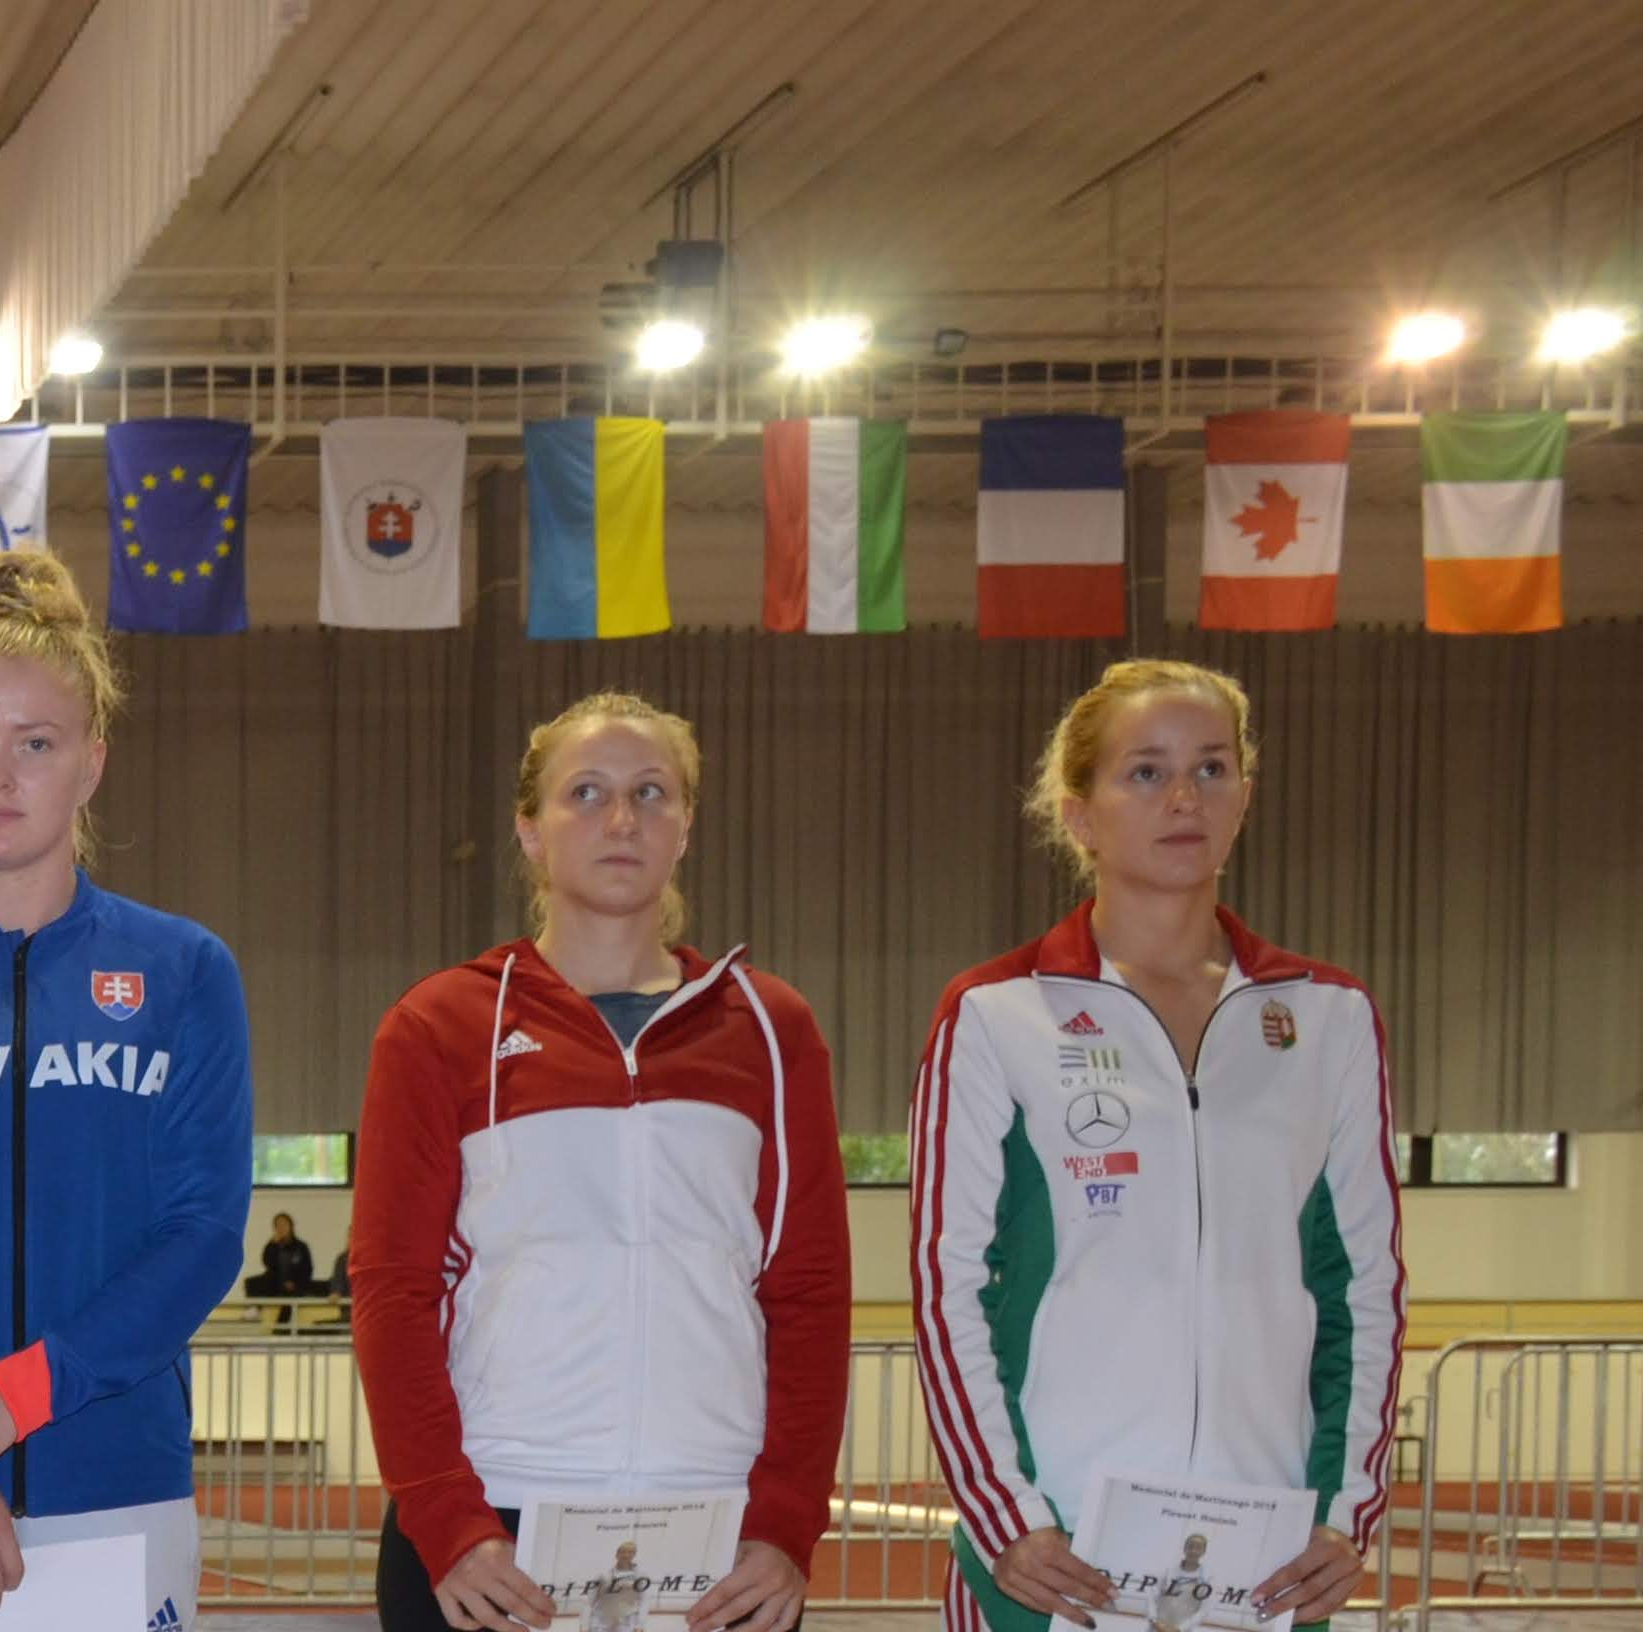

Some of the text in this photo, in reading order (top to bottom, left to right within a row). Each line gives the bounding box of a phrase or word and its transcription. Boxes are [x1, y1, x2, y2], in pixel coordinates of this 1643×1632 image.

[1064, 1155, 1103, 1170] WEST
[1075, 1167, 1104, 1179] END
[1098, 1569, 1269, 1608] IPLOM
